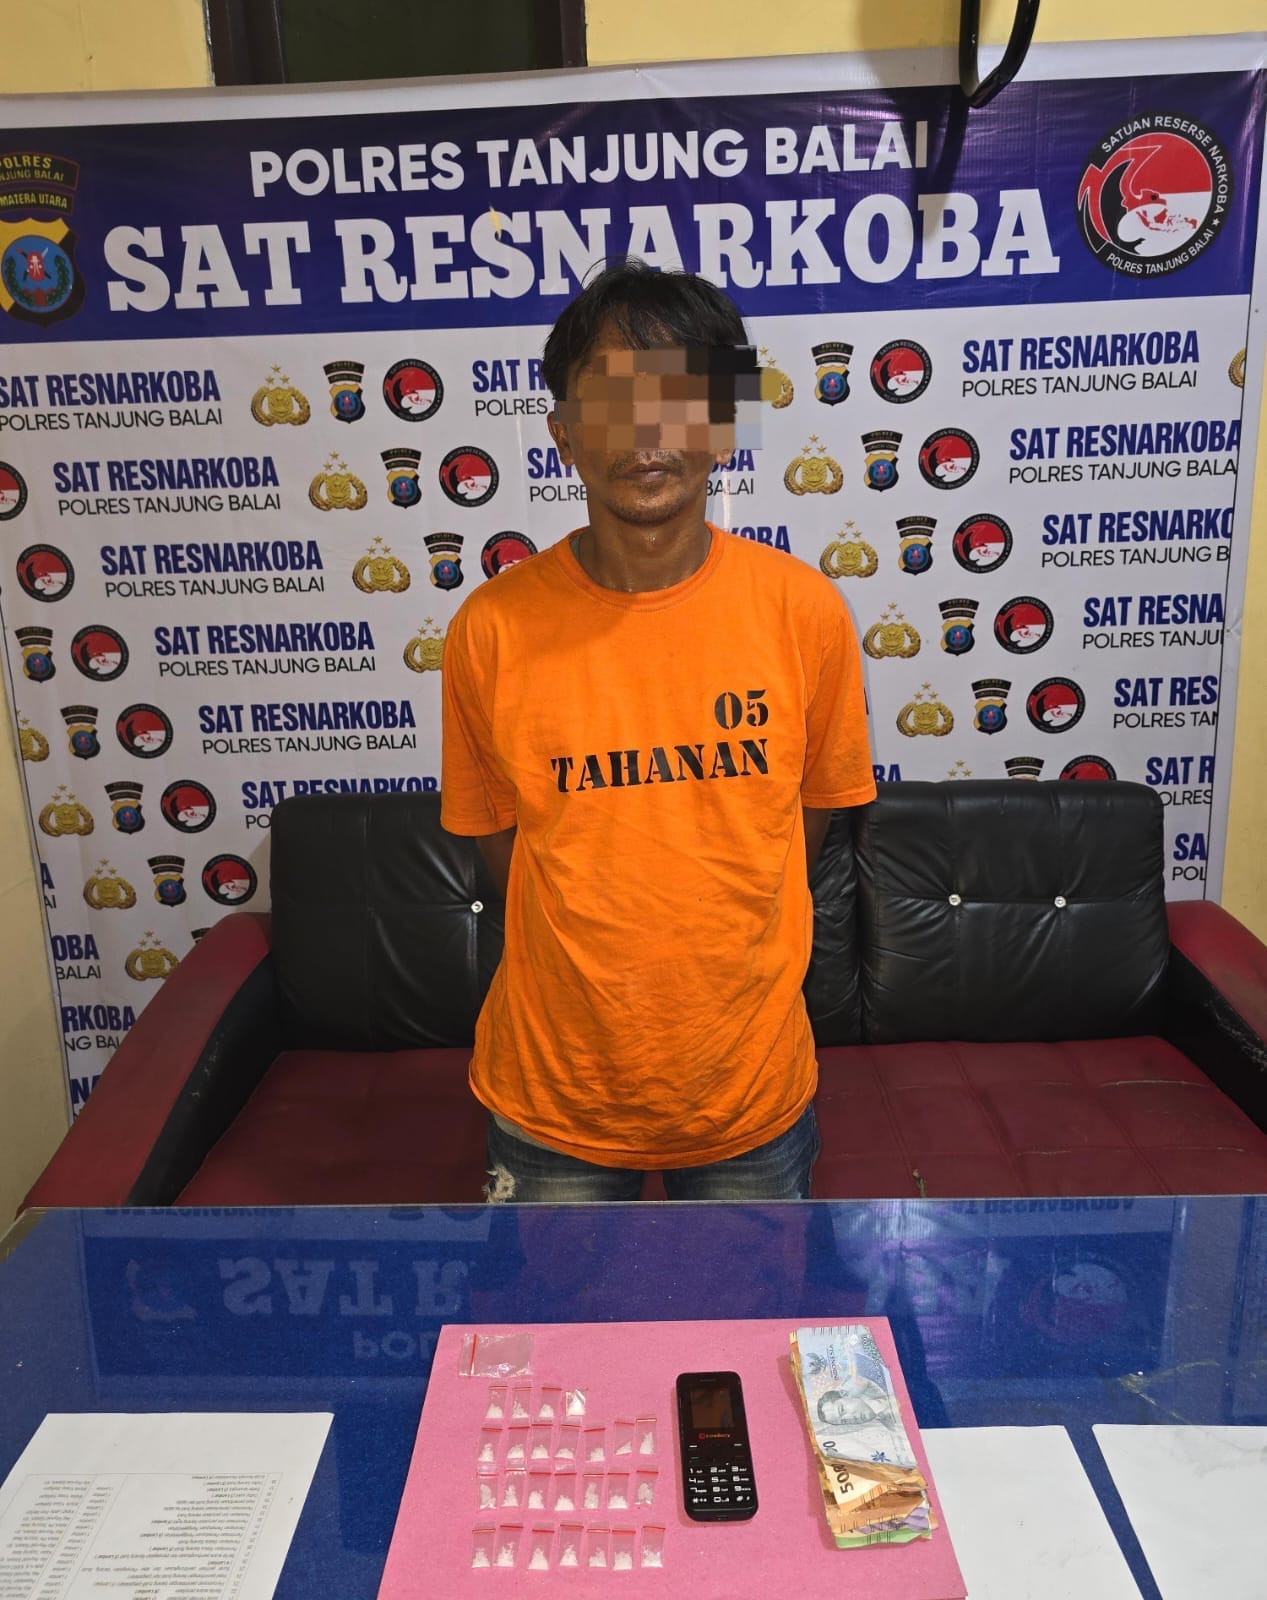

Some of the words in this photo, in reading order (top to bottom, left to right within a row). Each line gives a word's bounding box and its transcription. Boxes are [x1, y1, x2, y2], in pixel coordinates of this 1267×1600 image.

[0, 155, 52, 169] OLRES
[250, 142, 465, 198] POLRES
[476, 127, 748, 188] TANJUNG
[765, 121, 928, 176] BALAI
[1102, 117, 1150, 152] SATUAN
[1155, 116, 1212, 147] RESERSE
[1208, 145, 1228, 214] NARKOBA
[39, 193, 67, 208] UTARA
[104, 220, 311, 312] SAT
[335, 188, 1061, 304] RESNARKOBA
[1106, 252, 1142, 274] POLRES
[1145, 254, 1189, 274] TANJUNG
[1189, 228, 1215, 256] BALAI
[962, 339, 1013, 374] SAT
[1020, 330, 1200, 371] RESNARKOBA
[0, 375, 39, 408] SAT
[46, 370, 222, 406] RESNARKOBA
[472, 359, 520, 393] SAT
[962, 377, 1037, 397] POLRES
[1042, 373, 1137, 394] TANJUNG
[1142, 370, 1197, 390] BALAI
[0, 412, 70, 431] POLRES
[73, 410, 165, 430] TANJUNG
[169, 408, 222, 427] BALAI
[475, 397, 548, 416] POLRES
[1010, 427, 1060, 461] SAT
[1067, 419, 1241, 458] RESNARKOBA
[53, 461, 101, 494] SAT
[107, 456, 280, 492] RESNARKOBA
[1010, 464, 1083, 484] POLRES
[1088, 461, 1181, 481] TANJUNG
[58, 498, 130, 516] POLRES
[133, 495, 224, 514] TANJUNG
[229, 493, 281, 511] BALAI
[529, 484, 588, 502] POLRE
[1042, 514, 1092, 546] SAT
[100, 545, 147, 576] SAT
[153, 540, 324, 575] RESNARKOBA
[1041, 549, 1115, 568] POLRES
[1120, 546, 1212, 565] TANJUNG
[105, 580, 176, 598] POLRES
[179, 577, 269, 596] TANJUNG
[273, 575, 325, 593] BALAI
[1083, 597, 1133, 627] SAT
[154, 625, 200, 656] SAT
[207, 621, 375, 655] RESNARKOBA
[1082, 632, 1154, 649] POLRES
[159, 661, 229, 677] POLRES
[232, 657, 320, 675] TANJUNG
[325, 656, 376, 673] BALAI
[1114, 677, 1163, 707] SAT
[199, 704, 244, 734] SAT
[251, 700, 416, 733] RESNARKOBA
[714, 689, 769, 730] 05
[1113, 713, 1186, 729] POLRES
[202, 738, 272, 754] POLRES
[275, 736, 361, 753] TANJUNG
[367, 734, 417, 750] BALAI
[550, 739, 768, 793] TAHANAN
[1145, 756, 1194, 786] SAT
[242, 780, 287, 809] SAT
[1158, 789, 1213, 807] OLRES
